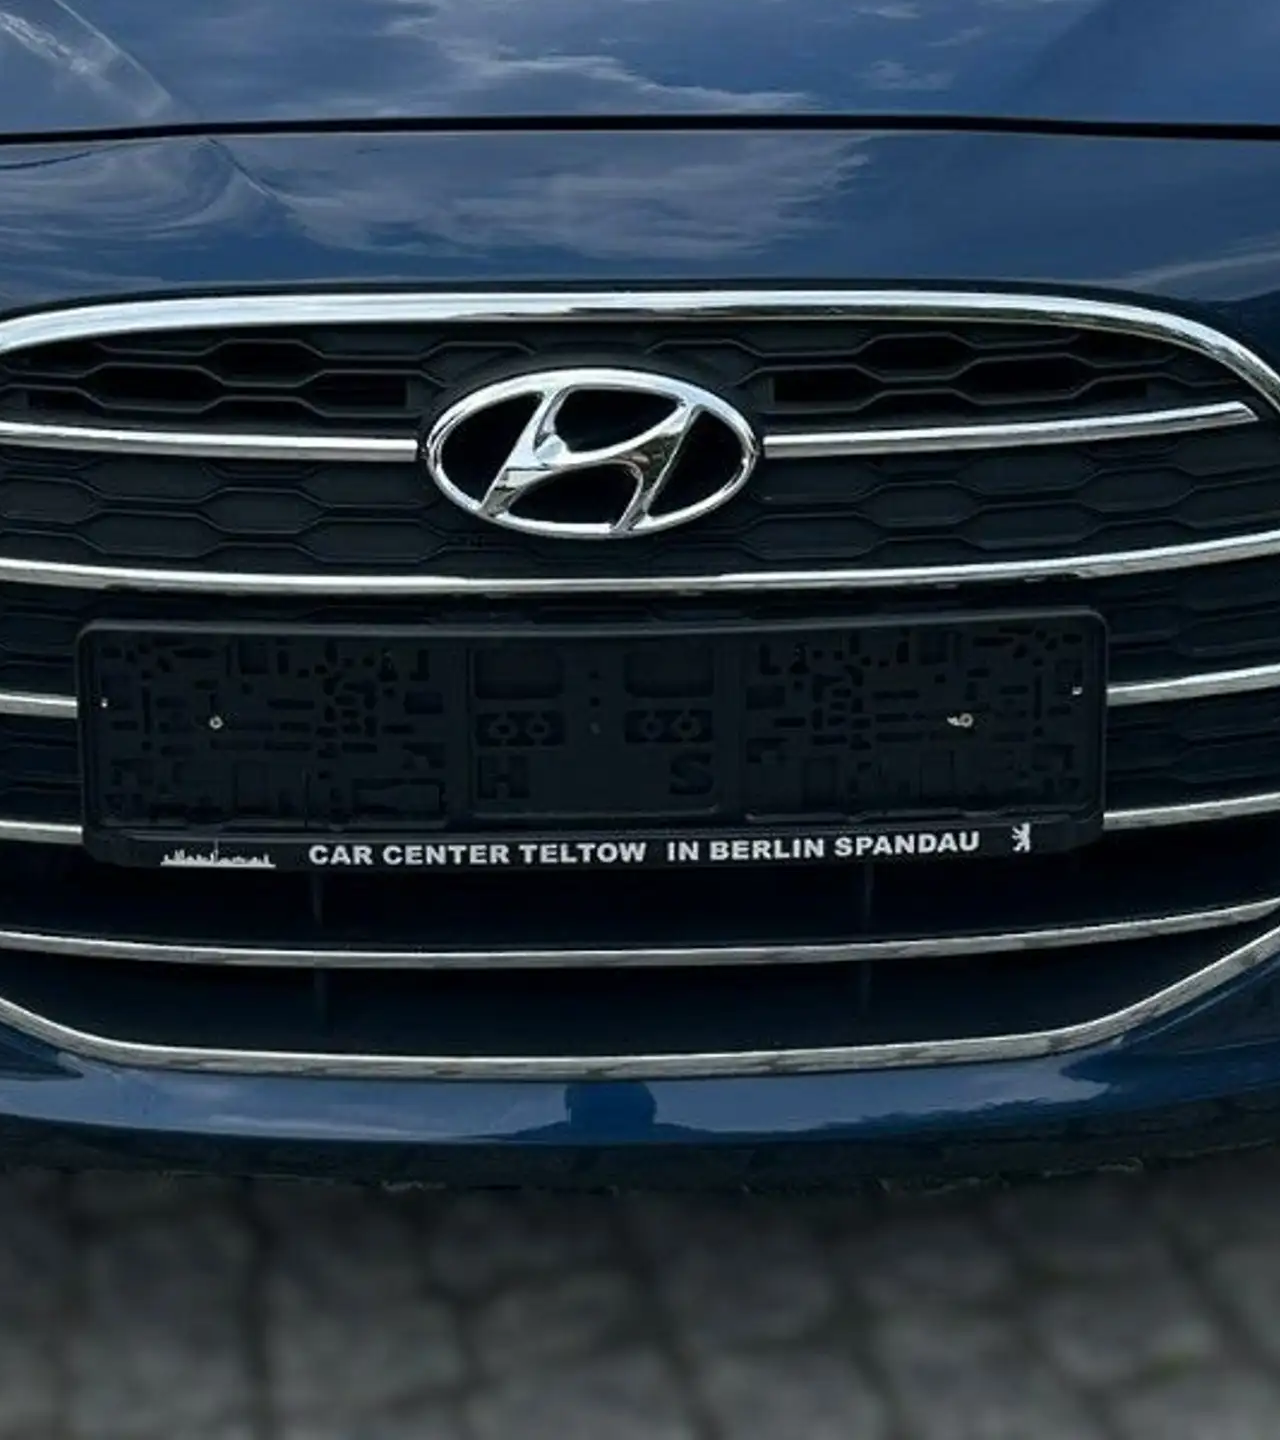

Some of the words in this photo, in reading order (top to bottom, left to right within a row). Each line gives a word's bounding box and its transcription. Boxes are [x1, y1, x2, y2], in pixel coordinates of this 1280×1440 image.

[308, 844, 373, 866] CAR
[382, 844, 510, 865] CENTER
[519, 842, 647, 864] TELTOW
[667, 841, 699, 862] IN
[709, 838, 824, 861] BERLIN
[834, 831, 980, 857] SPANDAU
